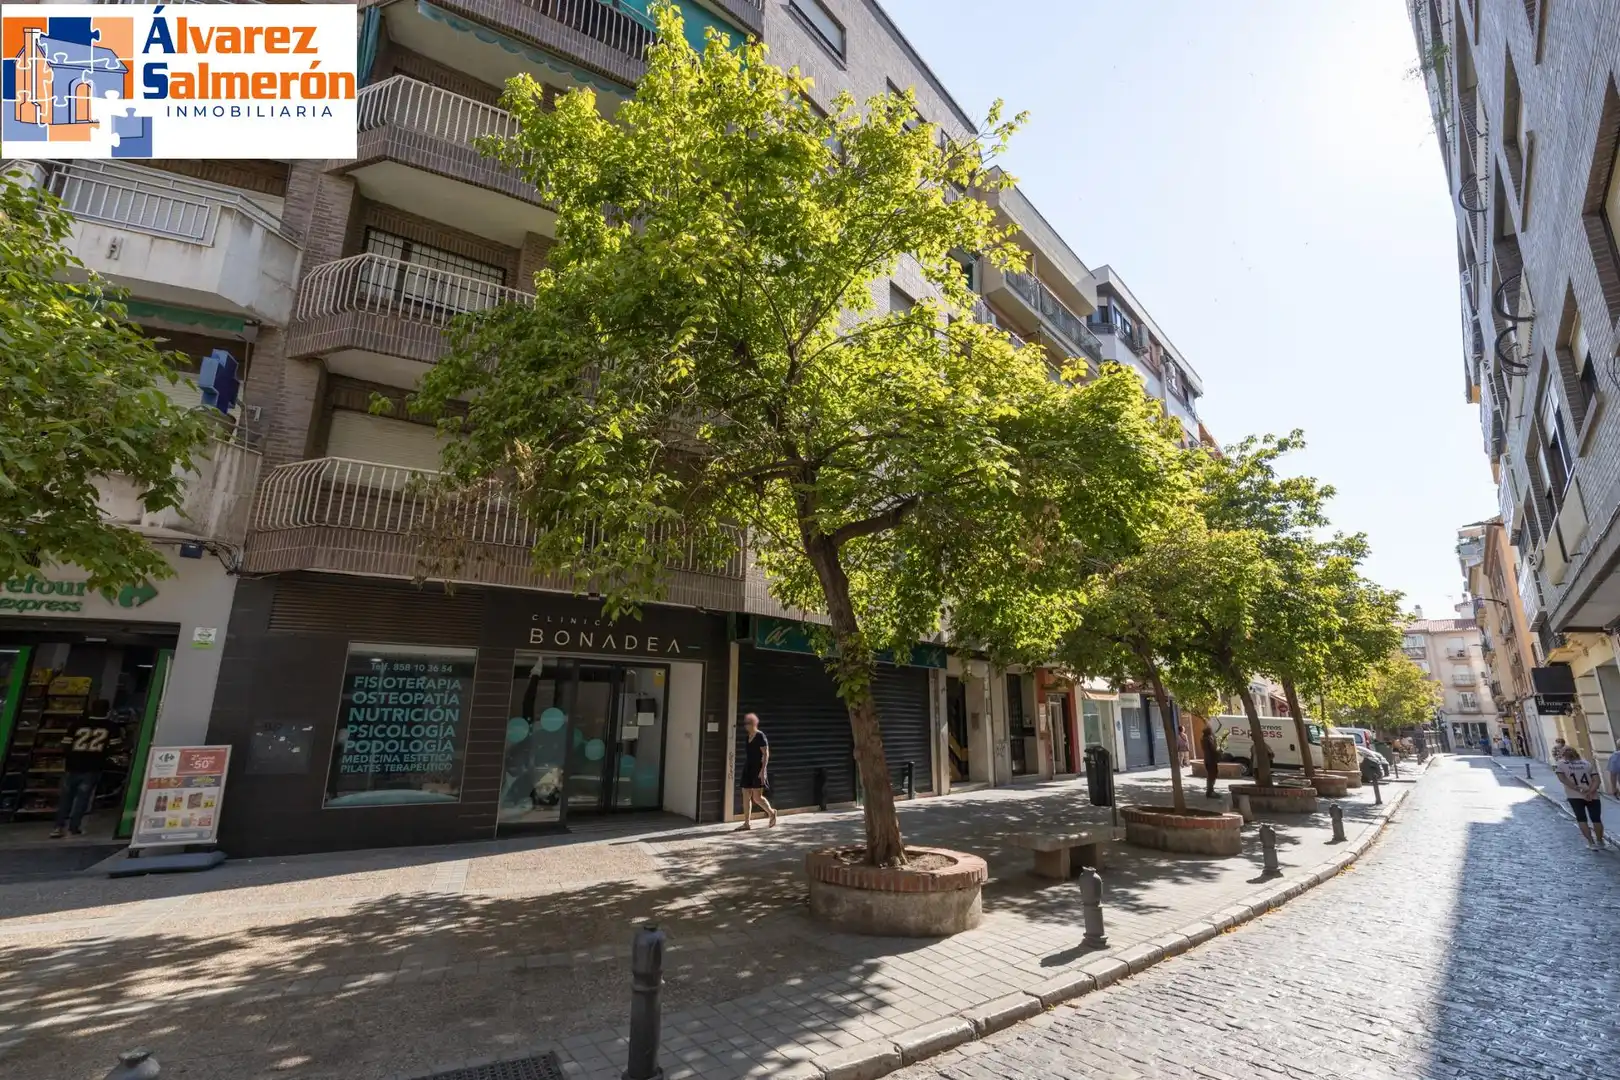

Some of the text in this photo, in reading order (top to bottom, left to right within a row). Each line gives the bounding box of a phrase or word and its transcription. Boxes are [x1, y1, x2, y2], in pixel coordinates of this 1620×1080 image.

[529, 628, 681, 654] BONADEA
[393, 663, 411, 671] 858
[414, 664, 425, 672] 10
[427, 664, 439, 672] 36
[441, 665, 453, 673] 54
[354, 675, 462, 690] FISIOTERAPIA
[352, 690, 460, 705] OSTEOPATÍA
[348, 706, 460, 722] NUTRICIÓN
[347, 722, 456, 738] PSICOLOGÍA
[1231, 726, 1283, 739] Expess
[72, 727, 110, 752] 22
[343, 736, 455, 753] PODOLOGÍA
[341, 754, 400, 764] MEDICINA
[340, 764, 381, 774] PILATES
[1570, 772, 1590, 786] 14
